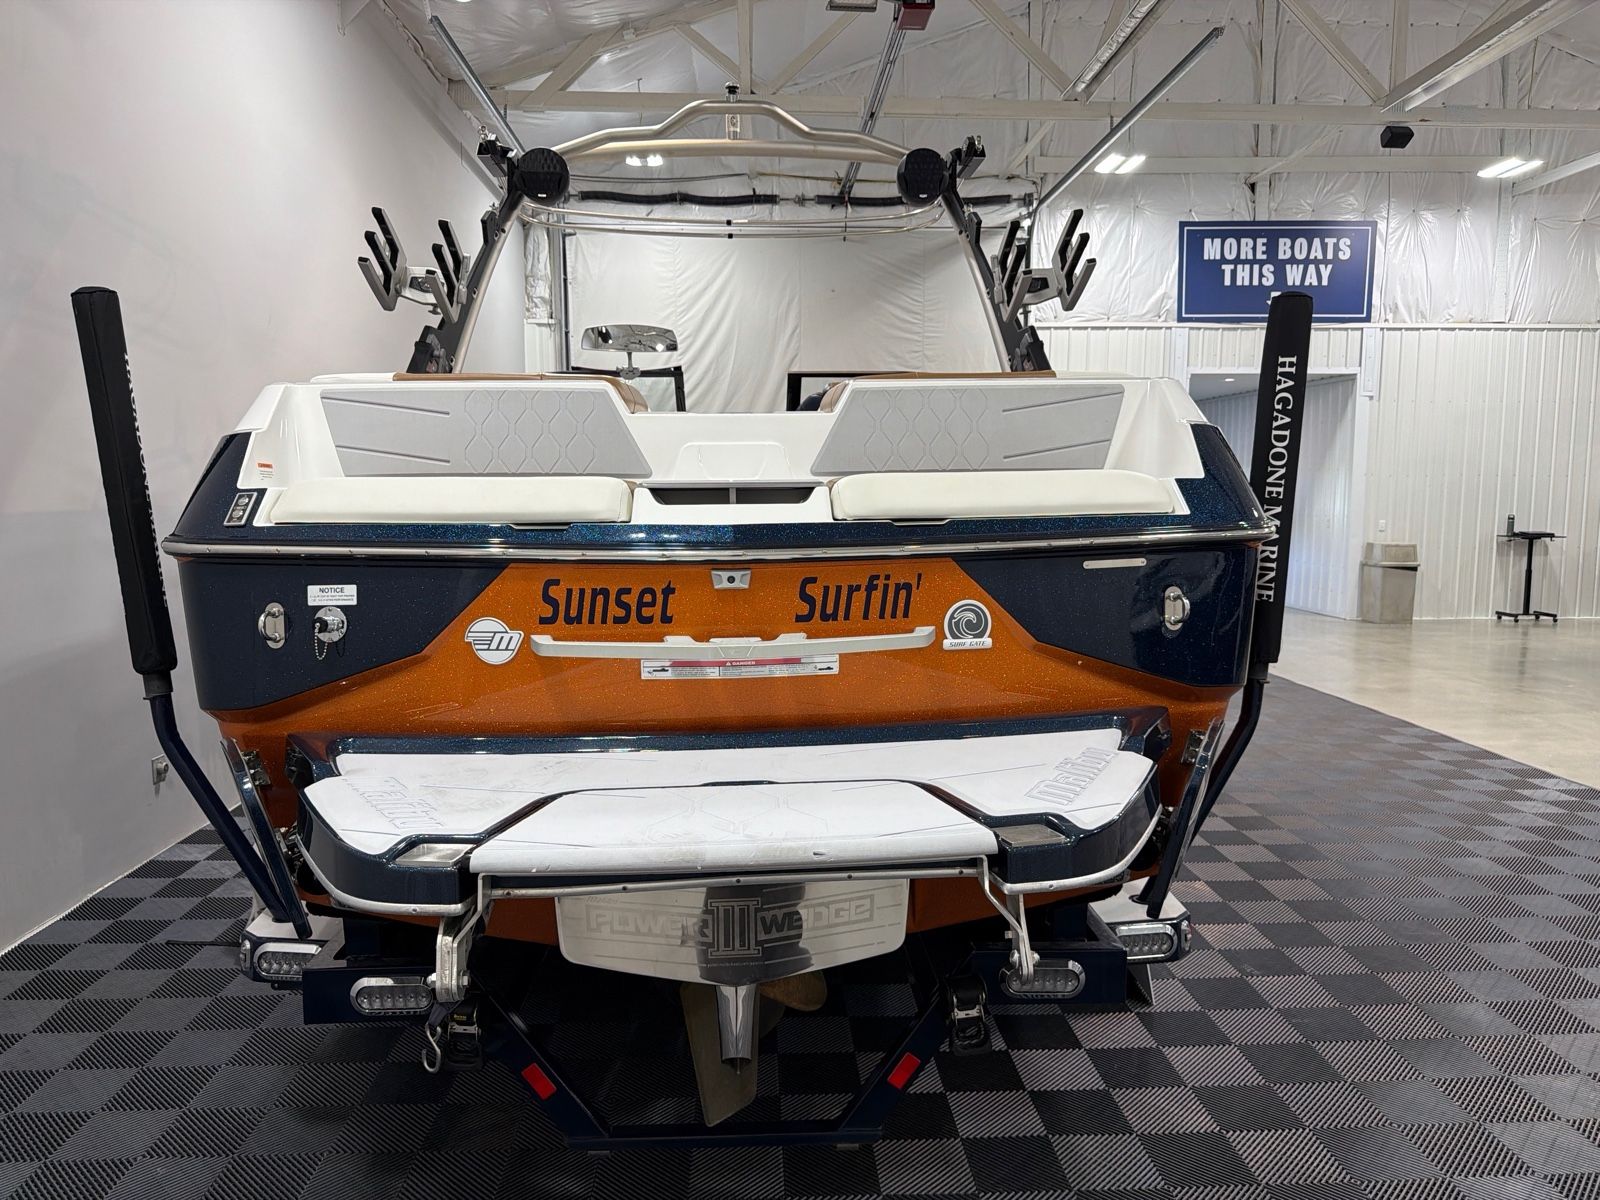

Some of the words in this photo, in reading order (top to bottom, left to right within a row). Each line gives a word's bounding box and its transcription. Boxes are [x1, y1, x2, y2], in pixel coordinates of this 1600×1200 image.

[1203, 237, 1268, 261] MORE
[1277, 237, 1352, 261] BOATS
[1221, 263, 1275, 287] THIS
[1285, 263, 1333, 287] WAY
[1264, 355, 1297, 499] HAGADONE
[319, 586, 345, 594] NOTICE
[539, 578, 676, 626] Sunset
[794, 572, 922, 623] Surfin'
[759, 896, 873, 936] WEDGE
